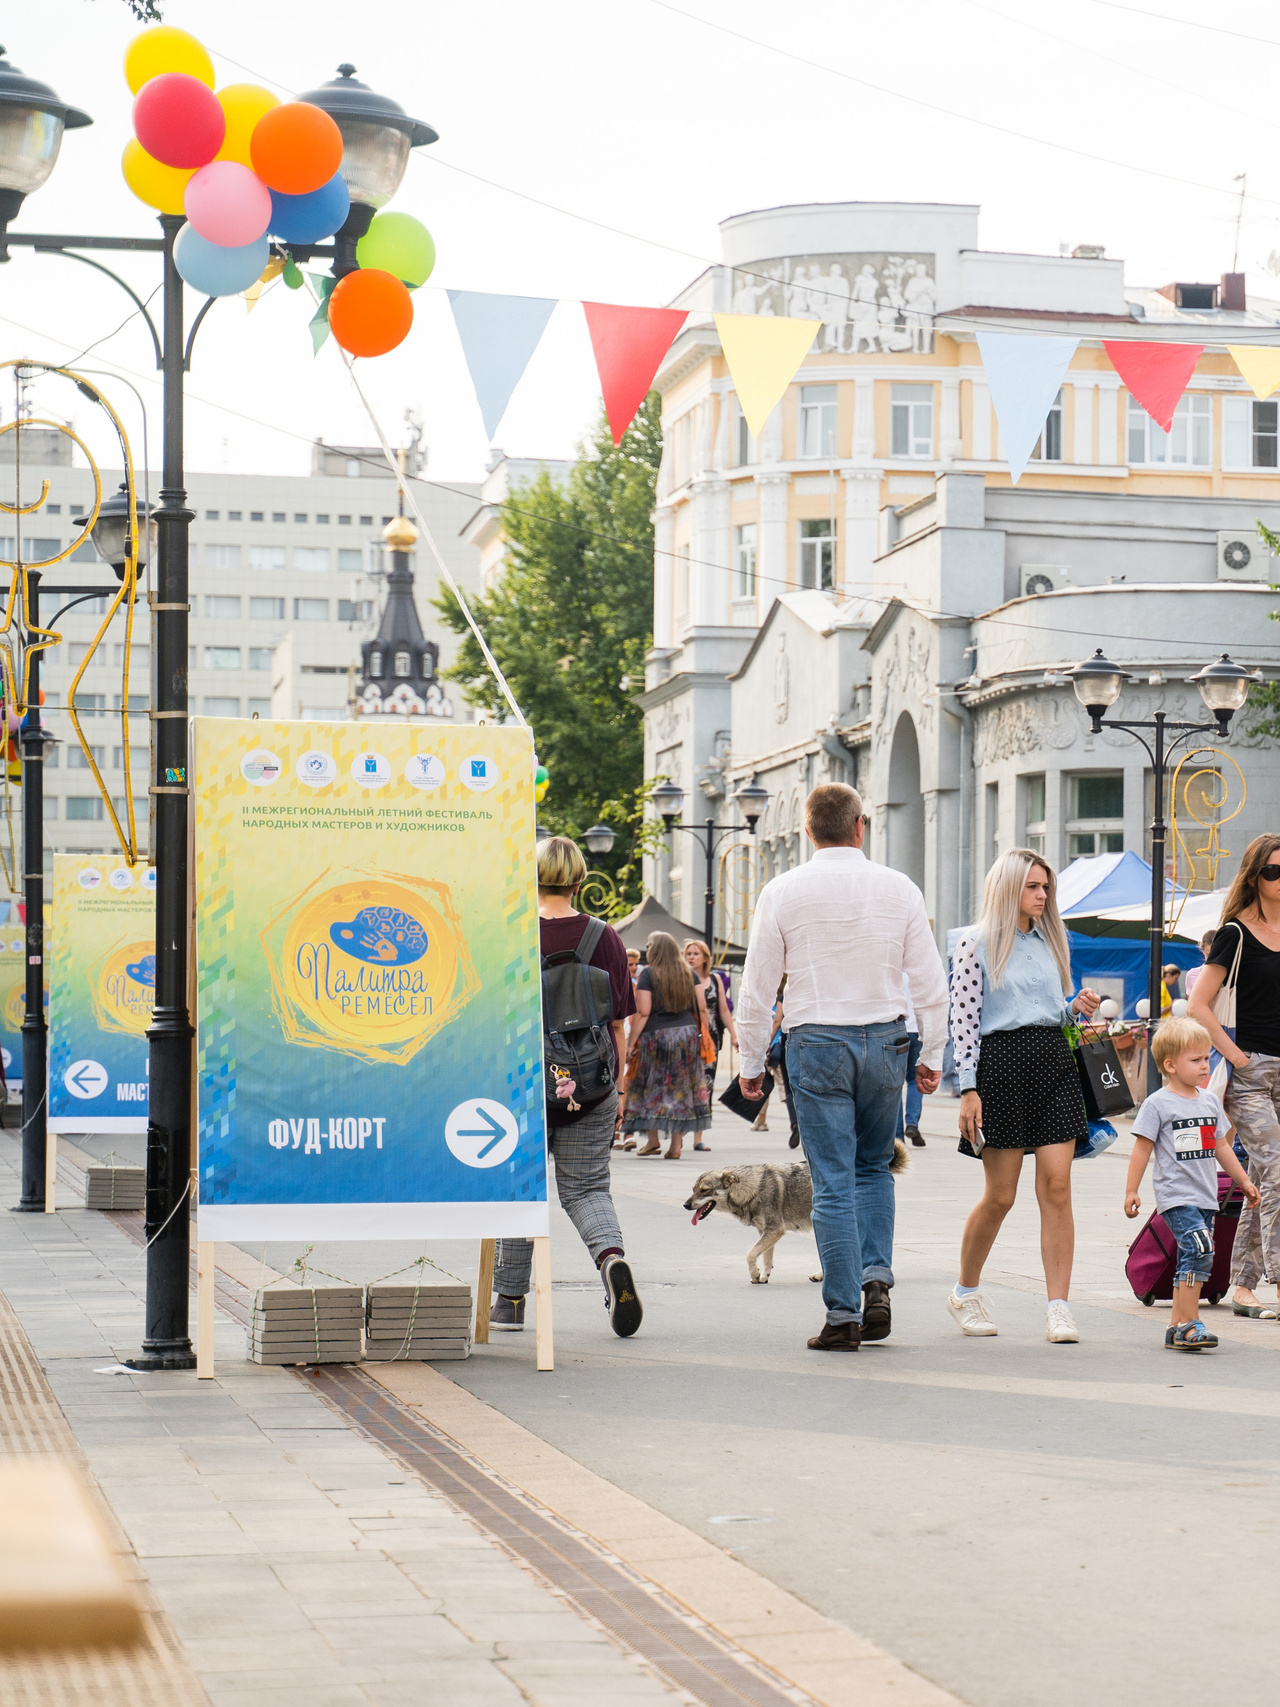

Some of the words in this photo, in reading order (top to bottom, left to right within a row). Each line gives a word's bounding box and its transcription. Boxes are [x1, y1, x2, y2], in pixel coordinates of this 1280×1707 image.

[242, 806, 249, 814] II
[252, 806, 374, 817] МЕЖРЕГИОНАЛЬНЫЙ
[377, 808, 422, 817] ЛЕТНИЙ
[425, 810, 493, 819] ФЕСТИВАЛЬ
[243, 820, 309, 829] НАРОДНЫХ
[312, 821, 372, 830] МАСТЕРОВ
[375, 822, 383, 830] И
[386, 822, 465, 832] ХУДОЖНИКОВ
[297, 942, 428, 1005] Палитра
[106, 974, 156, 1007] Пали
[131, 1004, 153, 1015] РЕМ
[341, 993, 432, 1015] РЕМЁСЕЛ
[1101, 1063, 1119, 1085] ck
[1177, 1118, 1216, 1128] TOMMY
[268, 1117, 386, 1154] ФУД-КОРТ
[1181, 1150, 1216, 1160] HILFIGE
